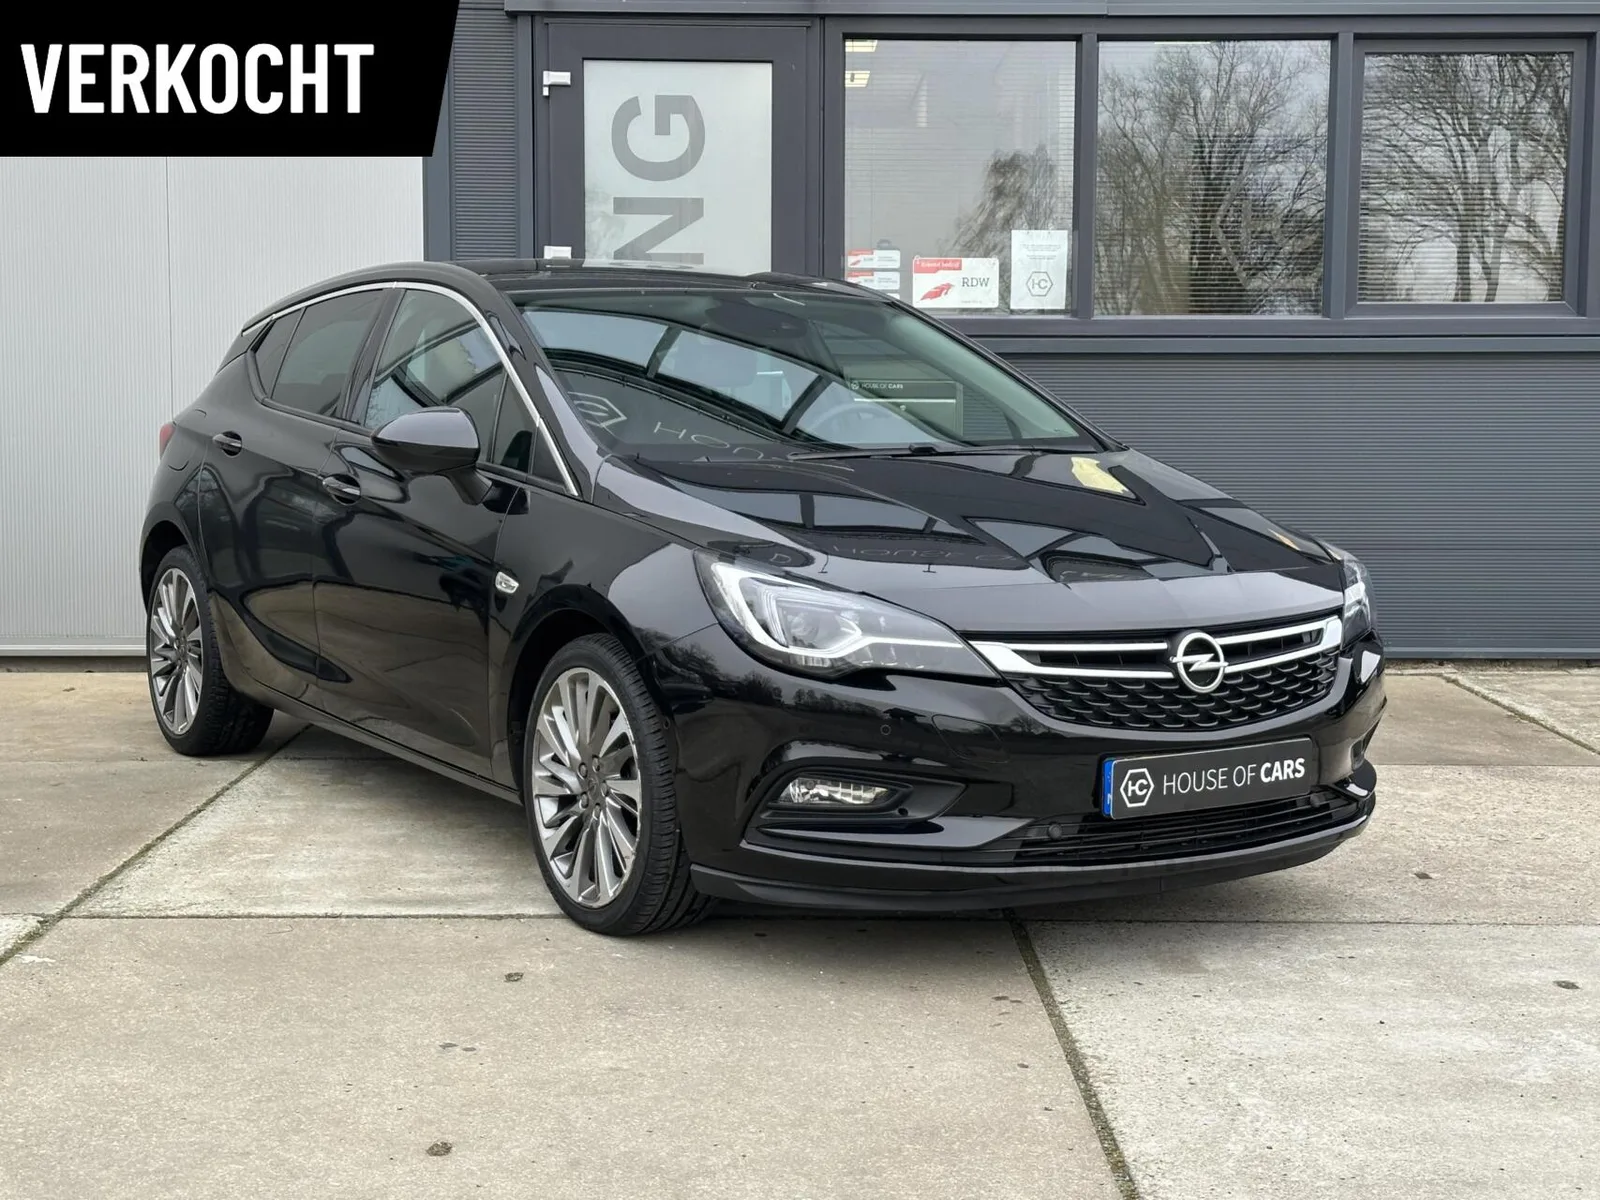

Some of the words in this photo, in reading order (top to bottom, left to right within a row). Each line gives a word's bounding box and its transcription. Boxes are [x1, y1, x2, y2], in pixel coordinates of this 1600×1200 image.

[961, 277, 990, 287] RDW
[1163, 768, 1228, 796] HOUSE
[1233, 764, 1257, 787] OF
[1260, 757, 1306, 783] CARS
